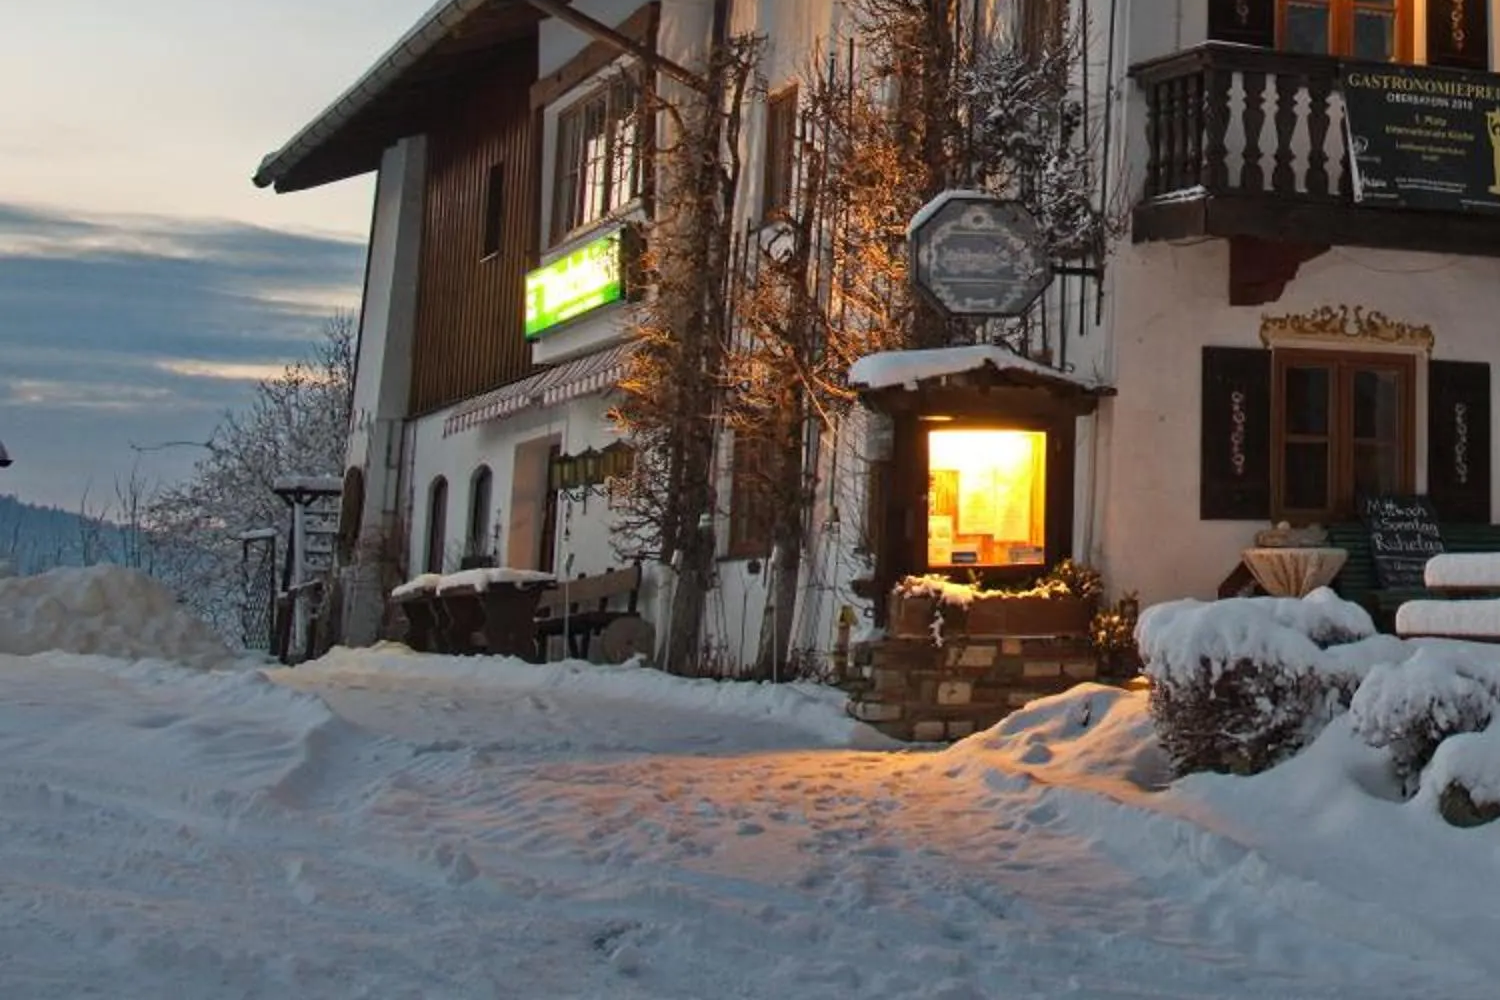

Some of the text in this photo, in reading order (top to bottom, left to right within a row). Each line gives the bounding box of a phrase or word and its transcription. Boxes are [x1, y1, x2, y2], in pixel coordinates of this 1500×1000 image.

[1386, 92, 1449, 107] OBERBAYERN
[1366, 498, 1428, 517] Mittwoch
[1381, 517, 1440, 538] Sonntag
